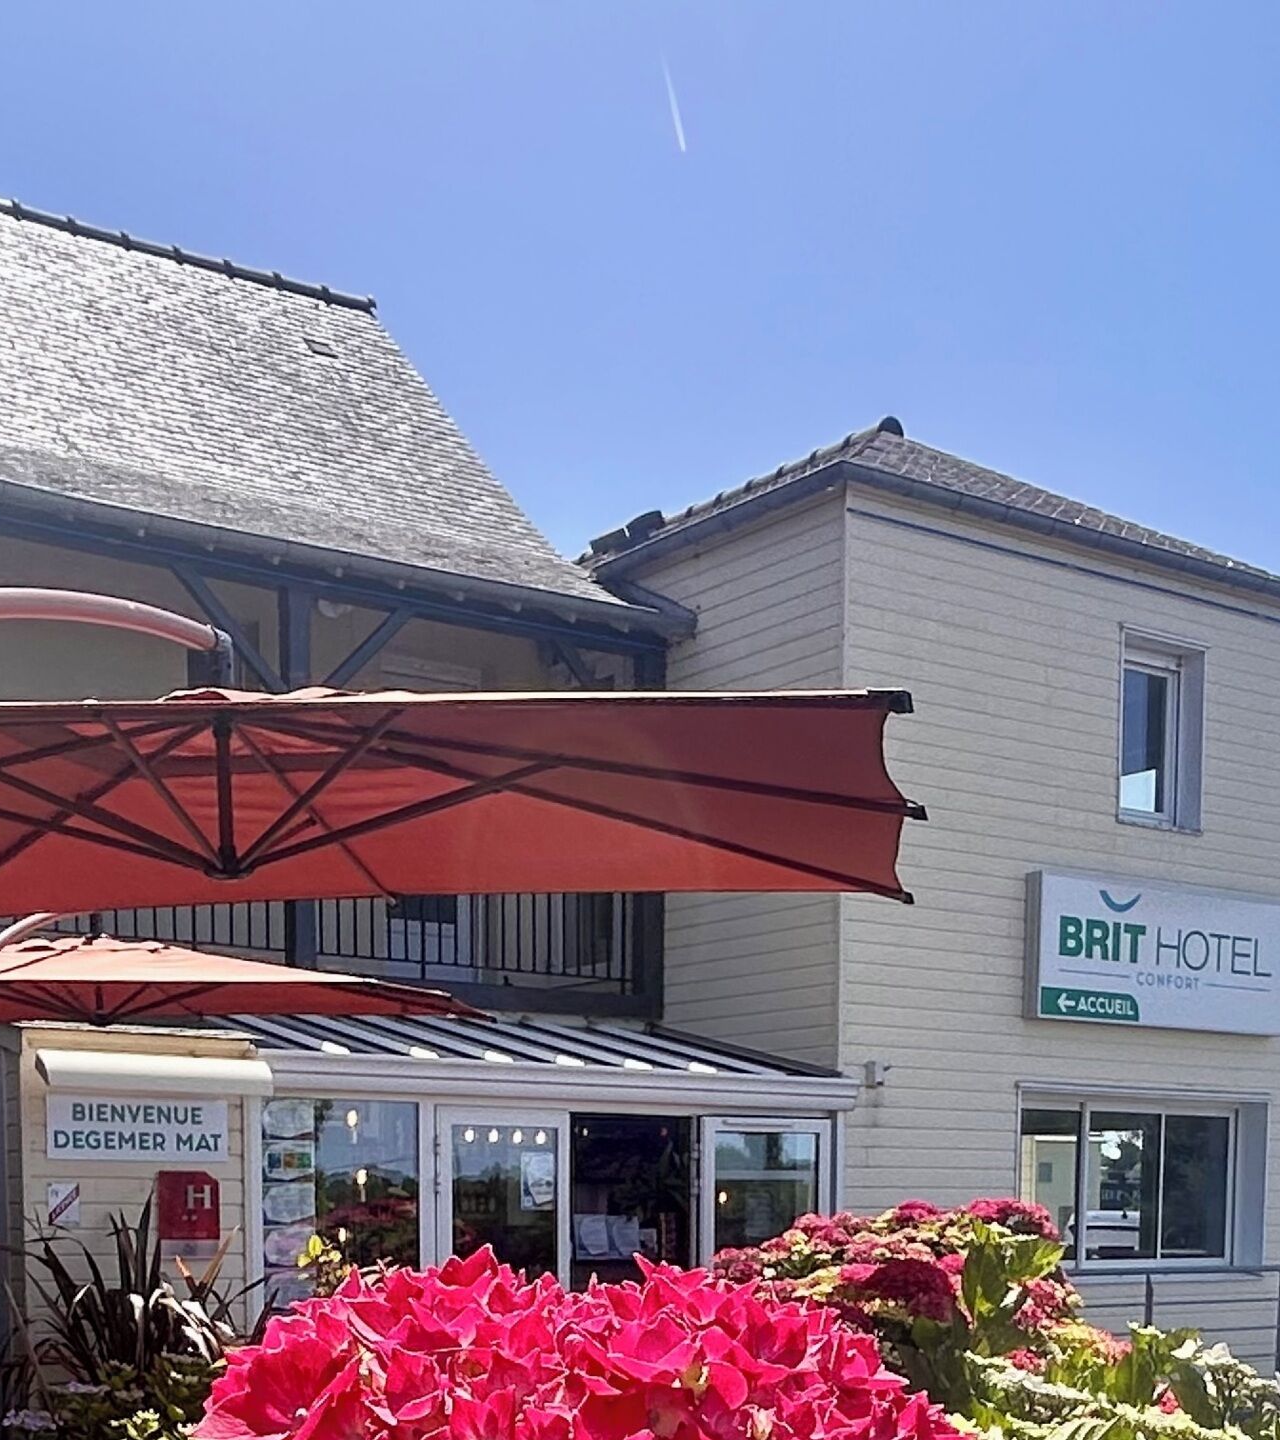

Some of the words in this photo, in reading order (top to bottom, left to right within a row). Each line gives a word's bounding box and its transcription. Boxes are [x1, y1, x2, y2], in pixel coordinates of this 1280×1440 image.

[1058, 914, 1147, 964] BRIT
[1156, 926, 1273, 978] HOTEL
[1135, 972, 1200, 991] CONFORT
[1076, 996, 1135, 1016] ACCUEIL
[72, 1103, 203, 1126] BIENVENUE
[53, 1130, 166, 1151] DEGEMER
[175, 1133, 222, 1152] MAT
[186, 1185, 212, 1209] H
